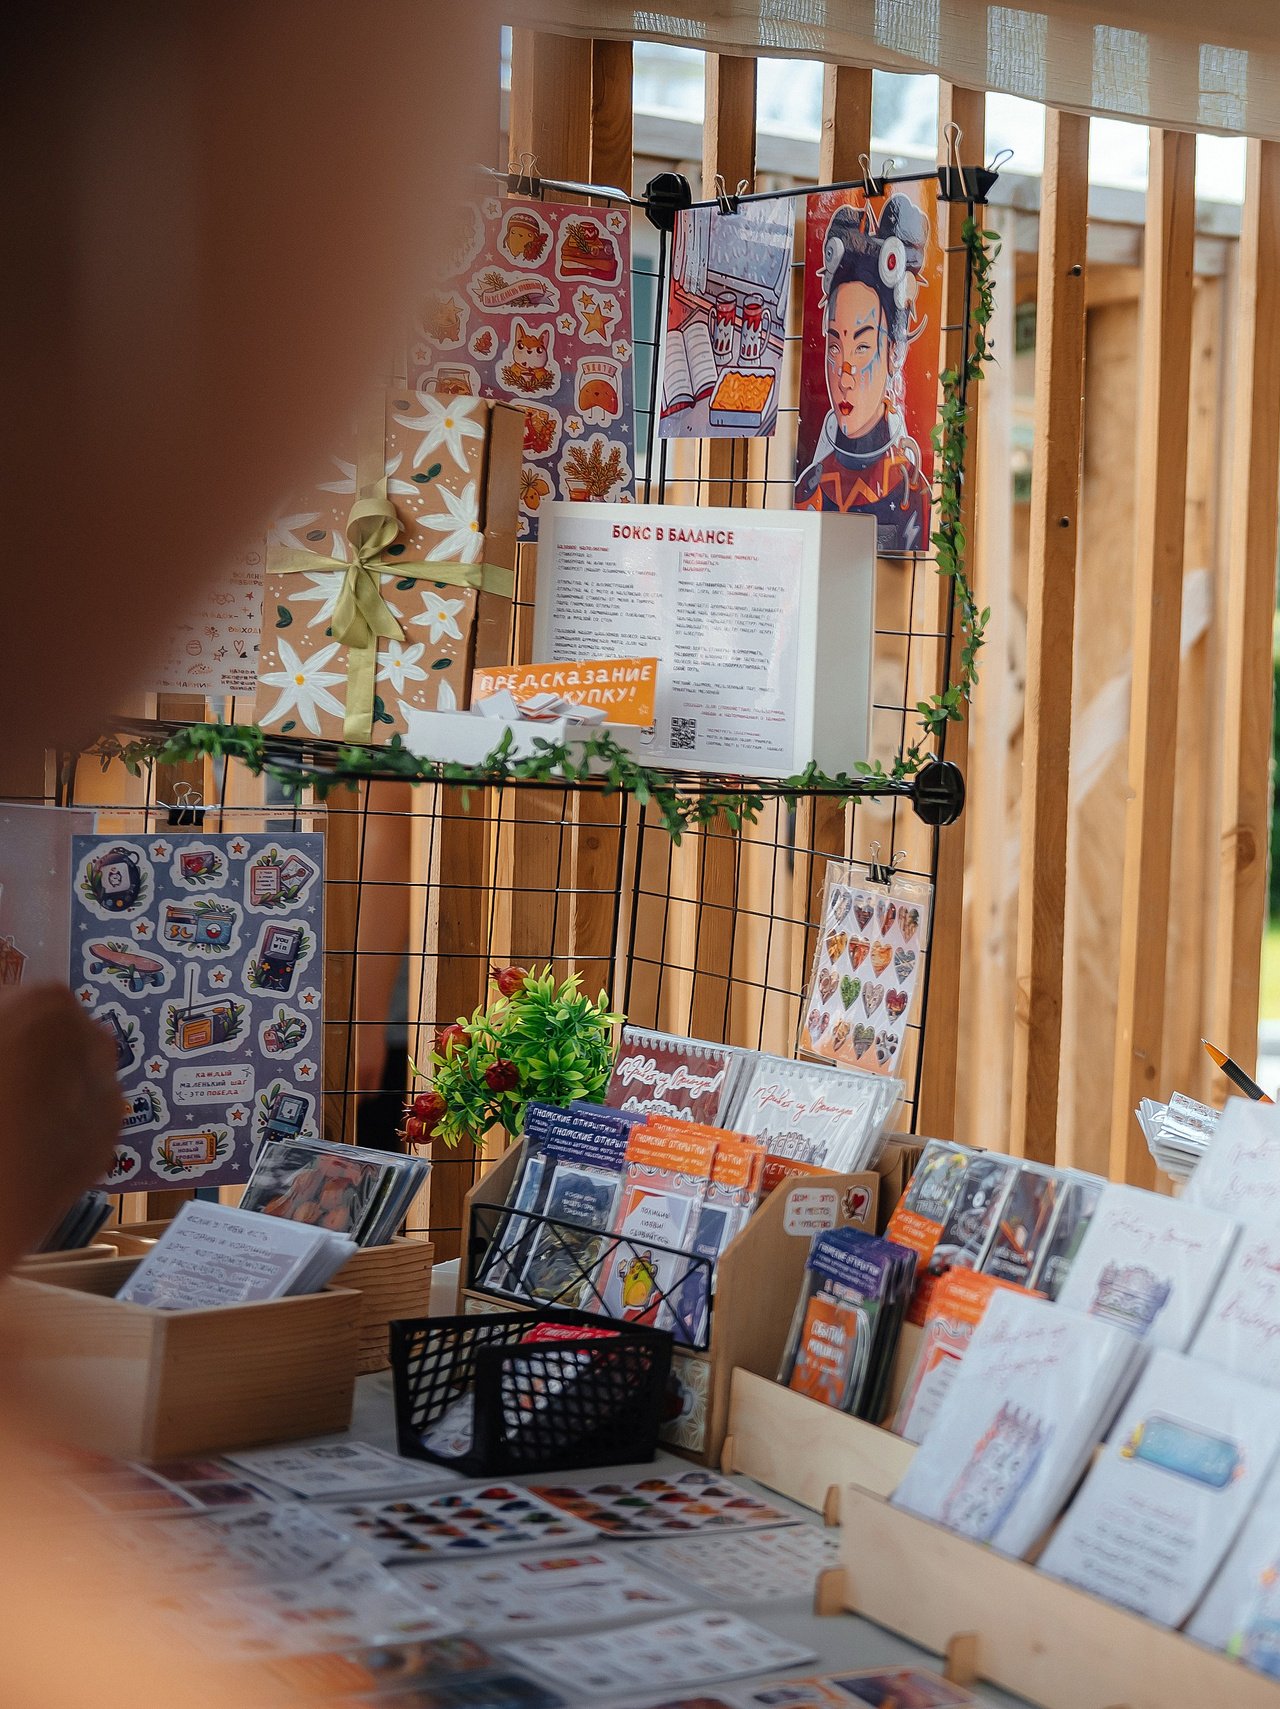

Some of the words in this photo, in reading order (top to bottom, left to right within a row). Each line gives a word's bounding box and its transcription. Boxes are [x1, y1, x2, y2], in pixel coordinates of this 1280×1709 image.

[612, 524, 651, 540] БОКС
[656, 527, 664, 541] В
[668, 527, 735, 546] БАЛАНСЕ
[228, 626, 262, 634] ВЫХОД
[553, 686, 637, 706] ОКУПКУ!
[122, 1113, 148, 1126] ADY!
[532, 1107, 573, 1125] ГНОМСКИЕ
[572, 1117, 617, 1134] ОТКРЫТКИ
[552, 1125, 594, 1142] ГНОМСКИЕ
[593, 1135, 629, 1149] ОТКРЫТ
[634, 1132, 667, 1148] ГНОМСКИЕ
[668, 1139, 706, 1156] ОТКРЫТКИ
[716, 1151, 743, 1165] РЫТКИ
[763, 1162, 810, 1177] КЕТЧБУК
[819, 1194, 835, 1202] ЭТО
